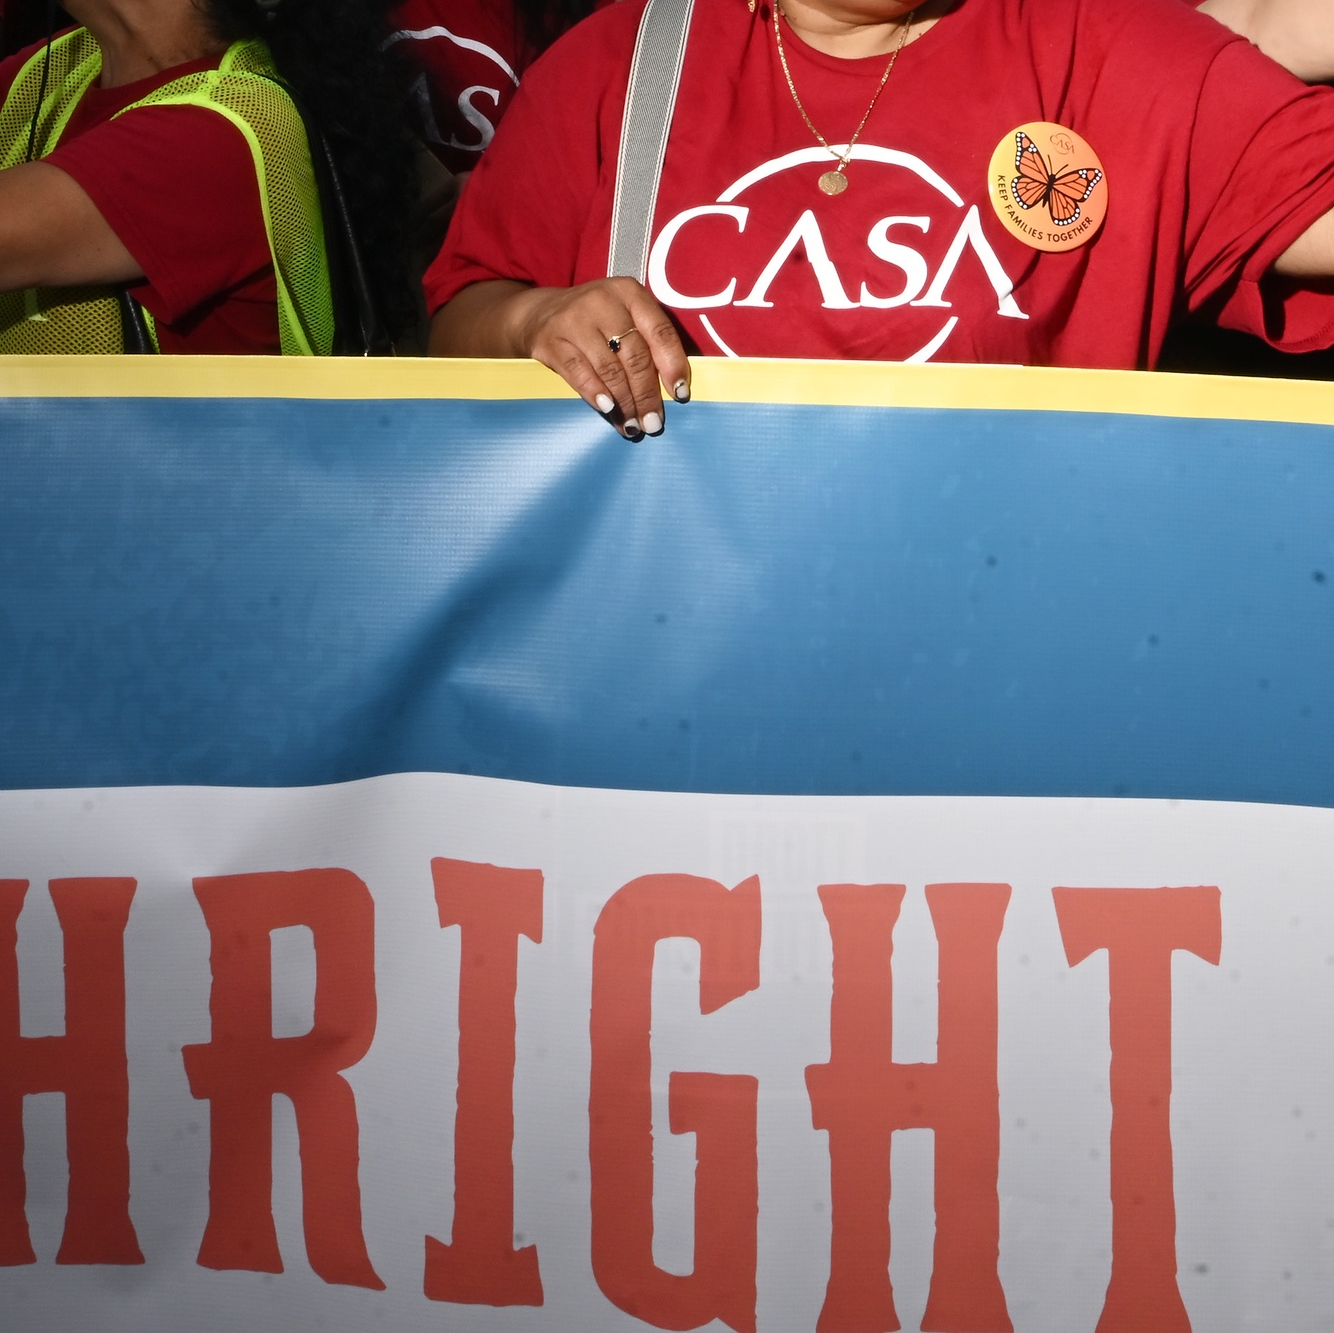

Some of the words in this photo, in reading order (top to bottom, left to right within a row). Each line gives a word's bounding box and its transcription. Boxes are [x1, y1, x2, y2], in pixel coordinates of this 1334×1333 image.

[1050, 134, 1074, 154] CASA
[998, 174, 1009, 201] KEEP
[1004, 204, 1043, 240] FAMILIES
[1047, 215, 1093, 243] TOGETHER
[648, 204, 1029, 319] CASA
